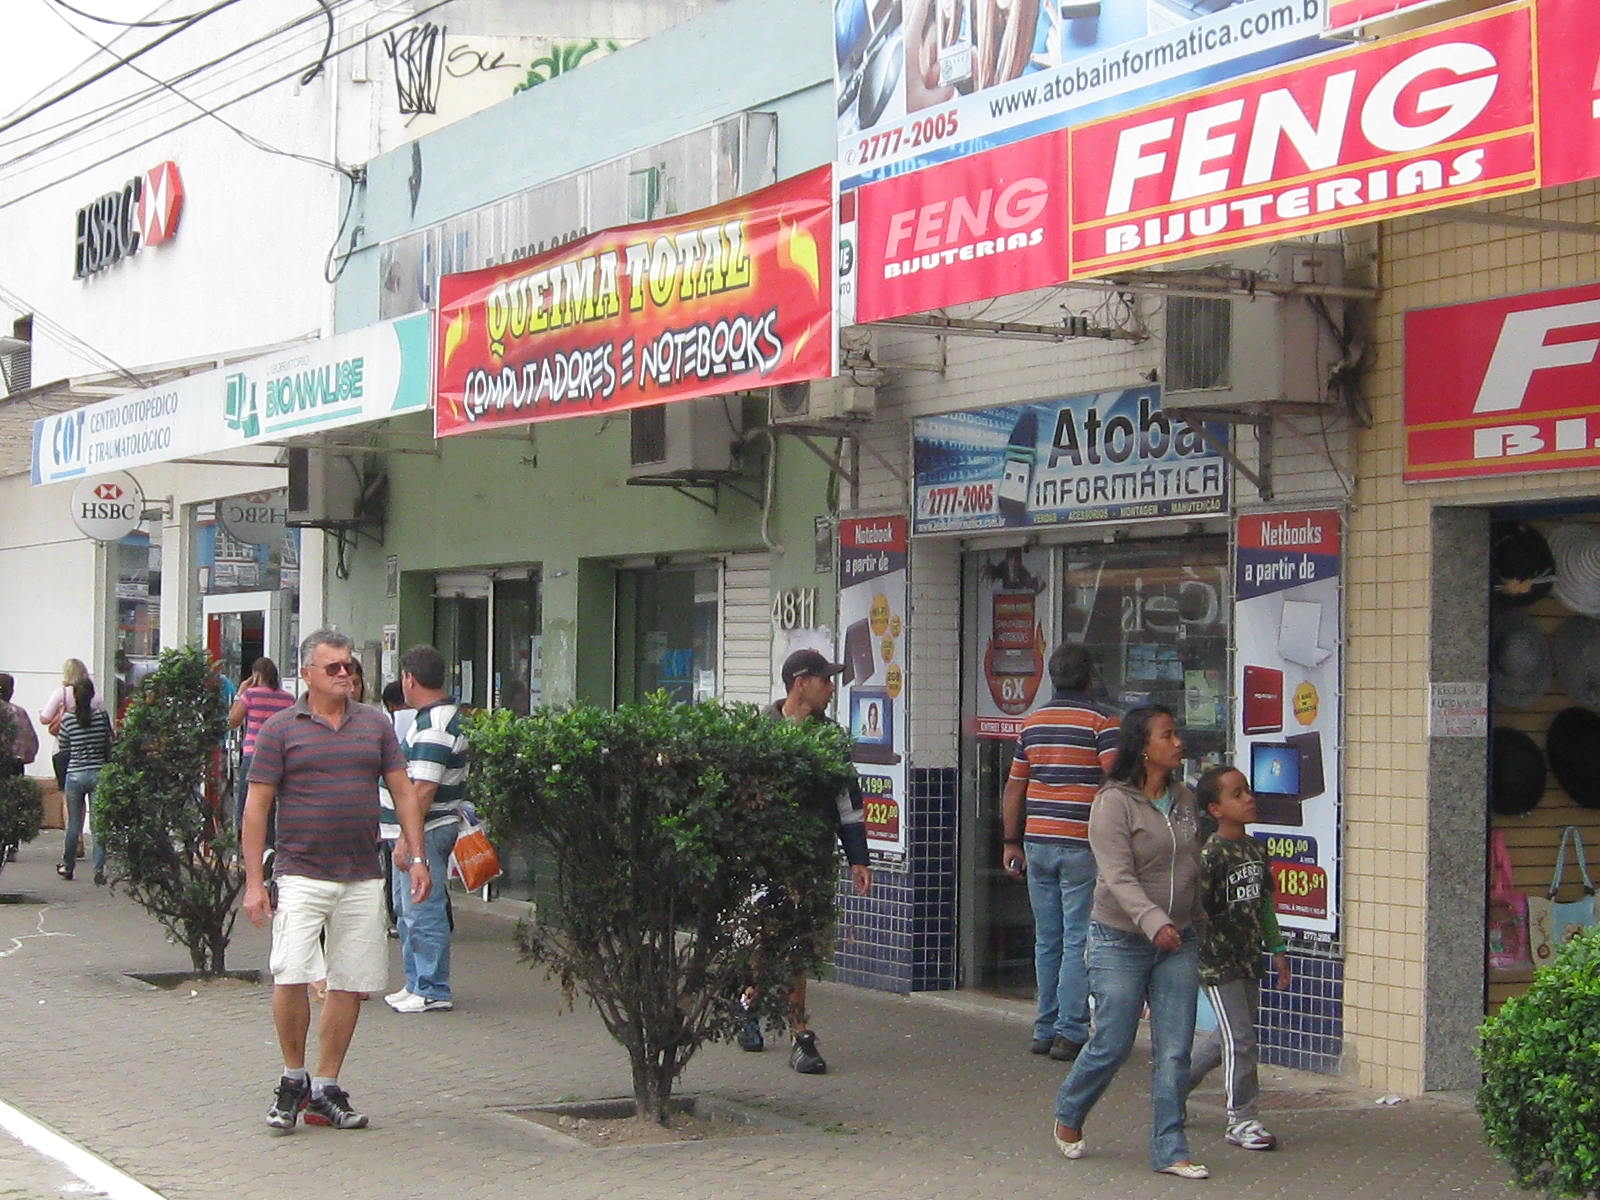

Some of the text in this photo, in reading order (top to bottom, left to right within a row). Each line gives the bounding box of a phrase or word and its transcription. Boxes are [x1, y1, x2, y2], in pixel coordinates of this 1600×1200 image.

[989, 0, 1318, 118] www.atobainformatica.com.b
[858, 109, 959, 166] 2777-2005
[1105, 42, 1499, 216] FENG
[885, 177, 1048, 259] FENG
[1105, 148, 1485, 255] BIJUTERIAS
[72, 176, 142, 280] HSBC
[884, 228, 1044, 279] BIJUTERIAS
[486, 249, 618, 358] QUEIMA
[625, 219, 751, 311] TOTAL
[265, 356, 364, 418] BIOANALISE
[463, 309, 784, 422] COMPUTADORES E NOTEBOOKS
[90, 391, 178, 434] CENTRO ORTOPÉDICO
[1047, 397, 1205, 469] Atoba
[52, 410, 86, 466] COT
[95, 426, 172, 463] TRAUMATOLÓGICO
[929, 483, 993, 515] 2777-2005
[1036, 462, 1220, 507] INFORMÁTICA
[81, 503, 135, 521] HSBC
[855, 522, 893, 544] Notebook
[1261, 518, 1322, 546] Netbooks
[852, 553, 876, 577] partir
[878, 551, 889, 571] de
[1245, 553, 1315, 586] a partir de
[772, 587, 815, 630] 4811
[1001, 678, 1025, 700] 6X
[1237, 883, 1259, 899] DEU
